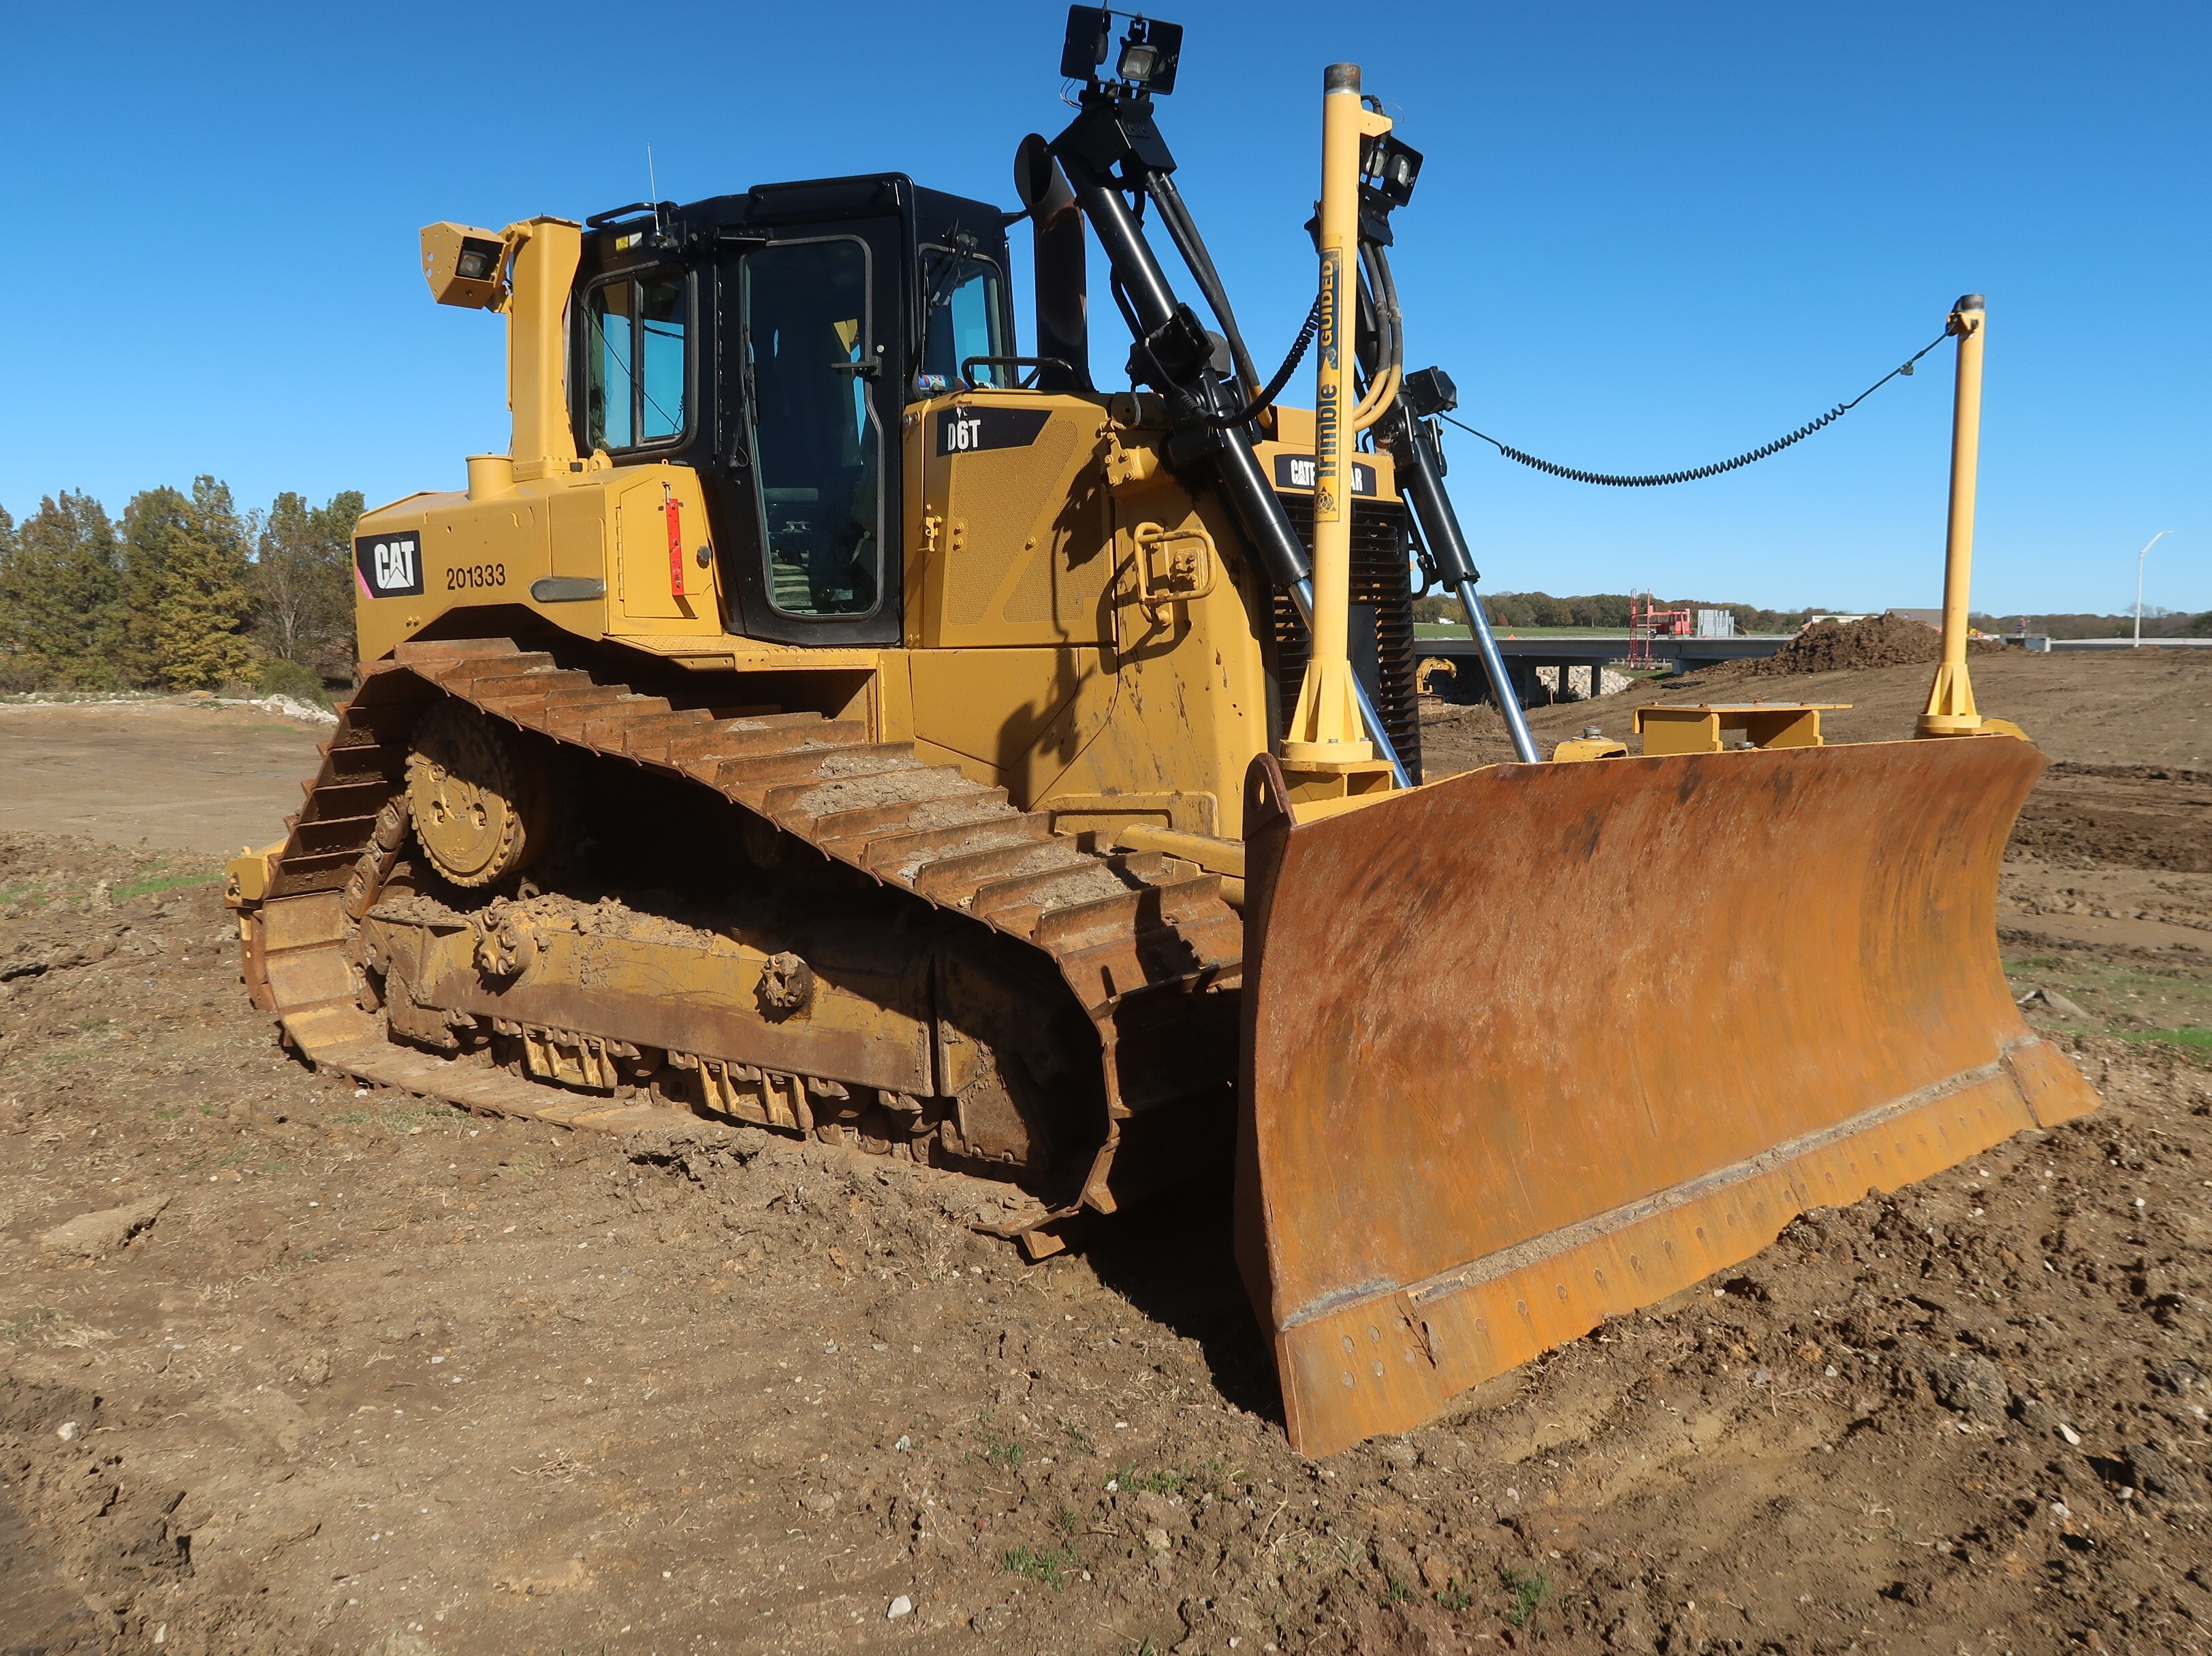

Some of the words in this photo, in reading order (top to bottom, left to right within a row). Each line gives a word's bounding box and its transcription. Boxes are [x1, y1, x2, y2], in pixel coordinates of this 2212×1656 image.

[1321, 260, 1333, 347] GUIDED
[948, 419, 981, 451] D6T
[1291, 459, 1363, 492] CATEAR
[375, 541, 415, 589] CAT
[447, 564, 505, 590] 201333
